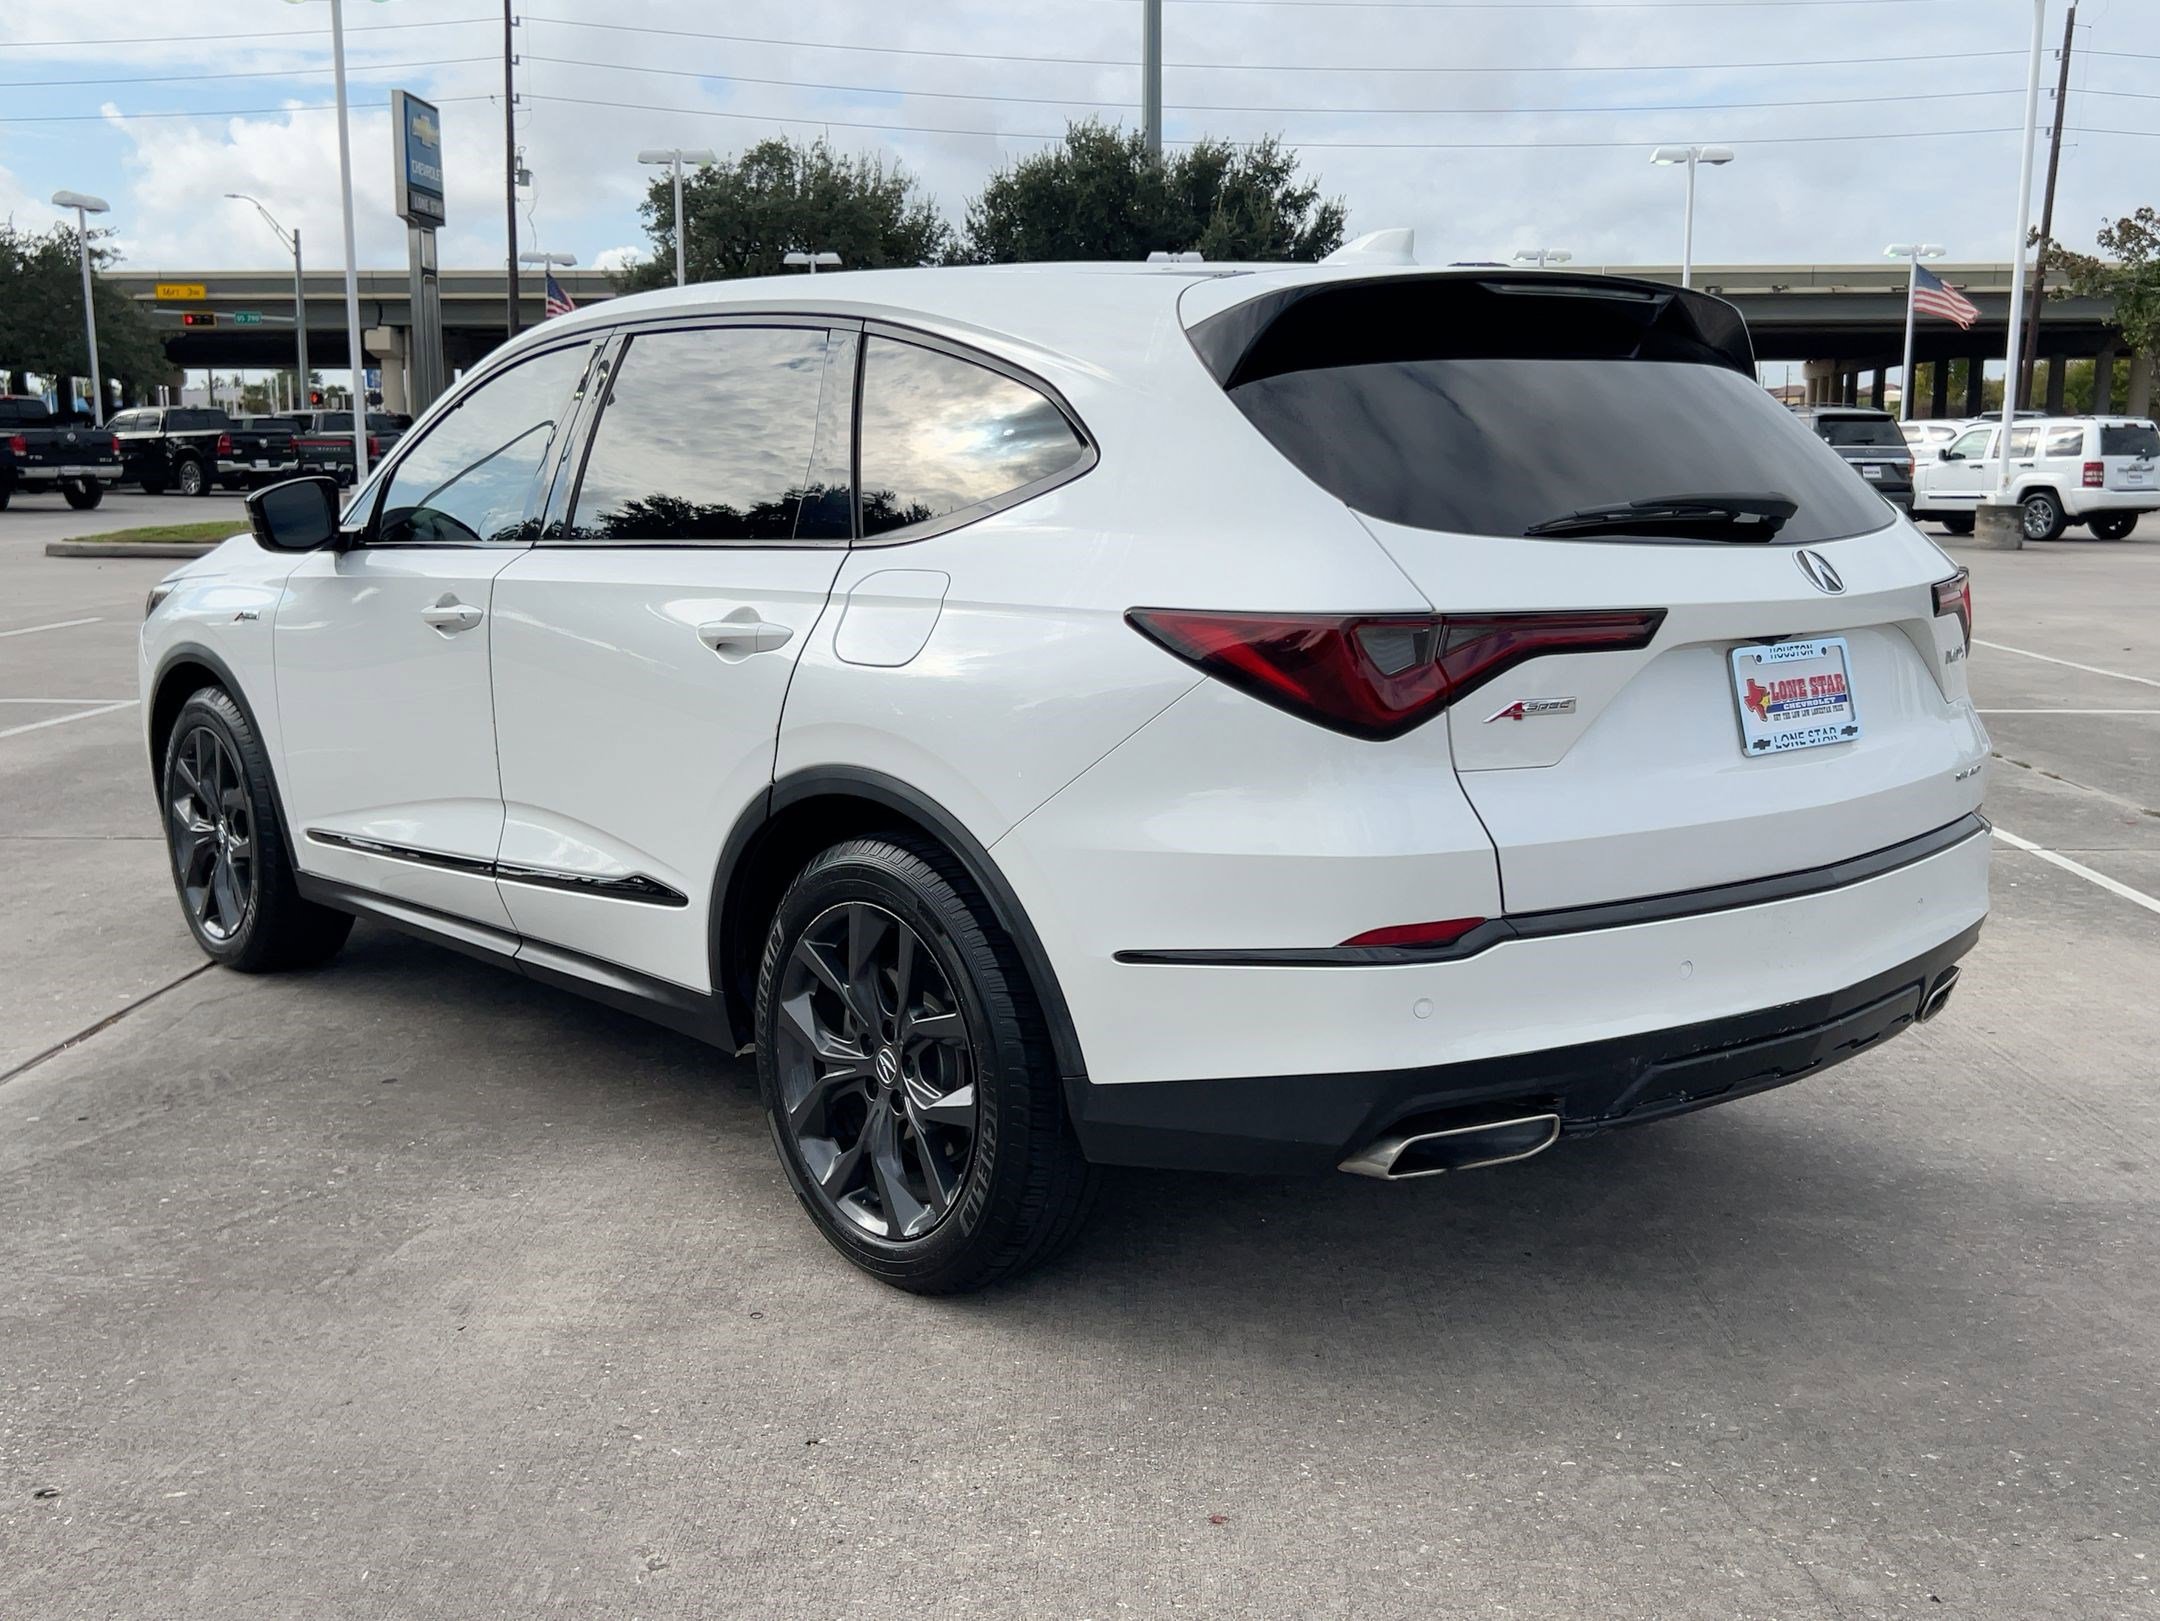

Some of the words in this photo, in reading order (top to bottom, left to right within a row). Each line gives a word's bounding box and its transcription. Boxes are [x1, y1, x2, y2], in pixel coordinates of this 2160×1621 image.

[411, 159, 442, 182] CHEVROLE
[1769, 643, 1814, 660] HOUSTON
[1769, 677, 1807, 702] LONE
[1808, 673, 1846, 697] STAR
[1783, 696, 1836, 710] CHEVROLET
[1773, 731, 1807, 749] LONE
[1808, 726, 1838, 743] STAR
